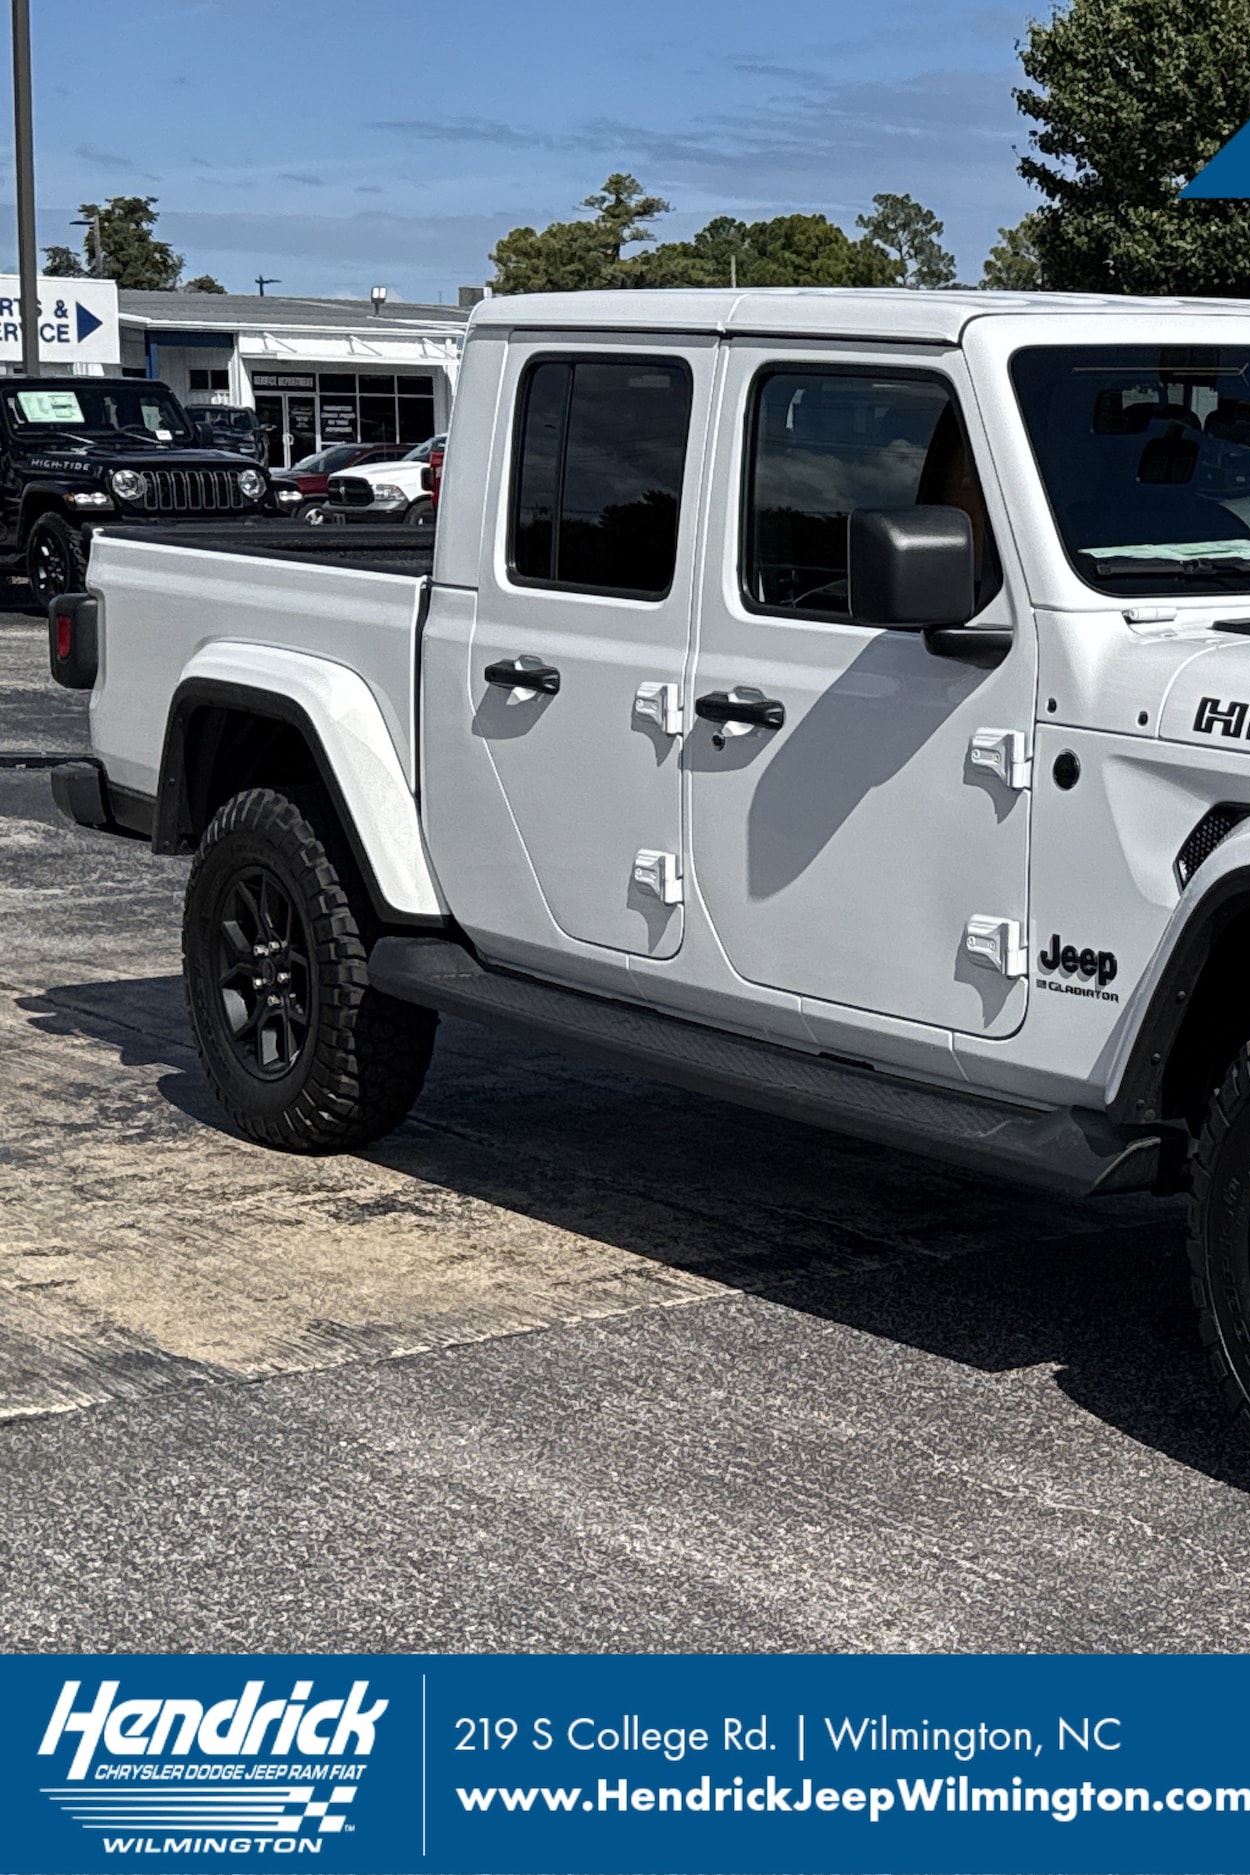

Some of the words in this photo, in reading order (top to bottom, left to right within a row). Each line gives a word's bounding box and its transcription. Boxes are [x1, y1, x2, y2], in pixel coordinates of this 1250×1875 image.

[53, 299, 69, 319] &
[63, 460, 91, 471] TIDE
[1040, 933, 1118, 987] Jeep
[1048, 981, 1120, 1003] GLADIATOR
